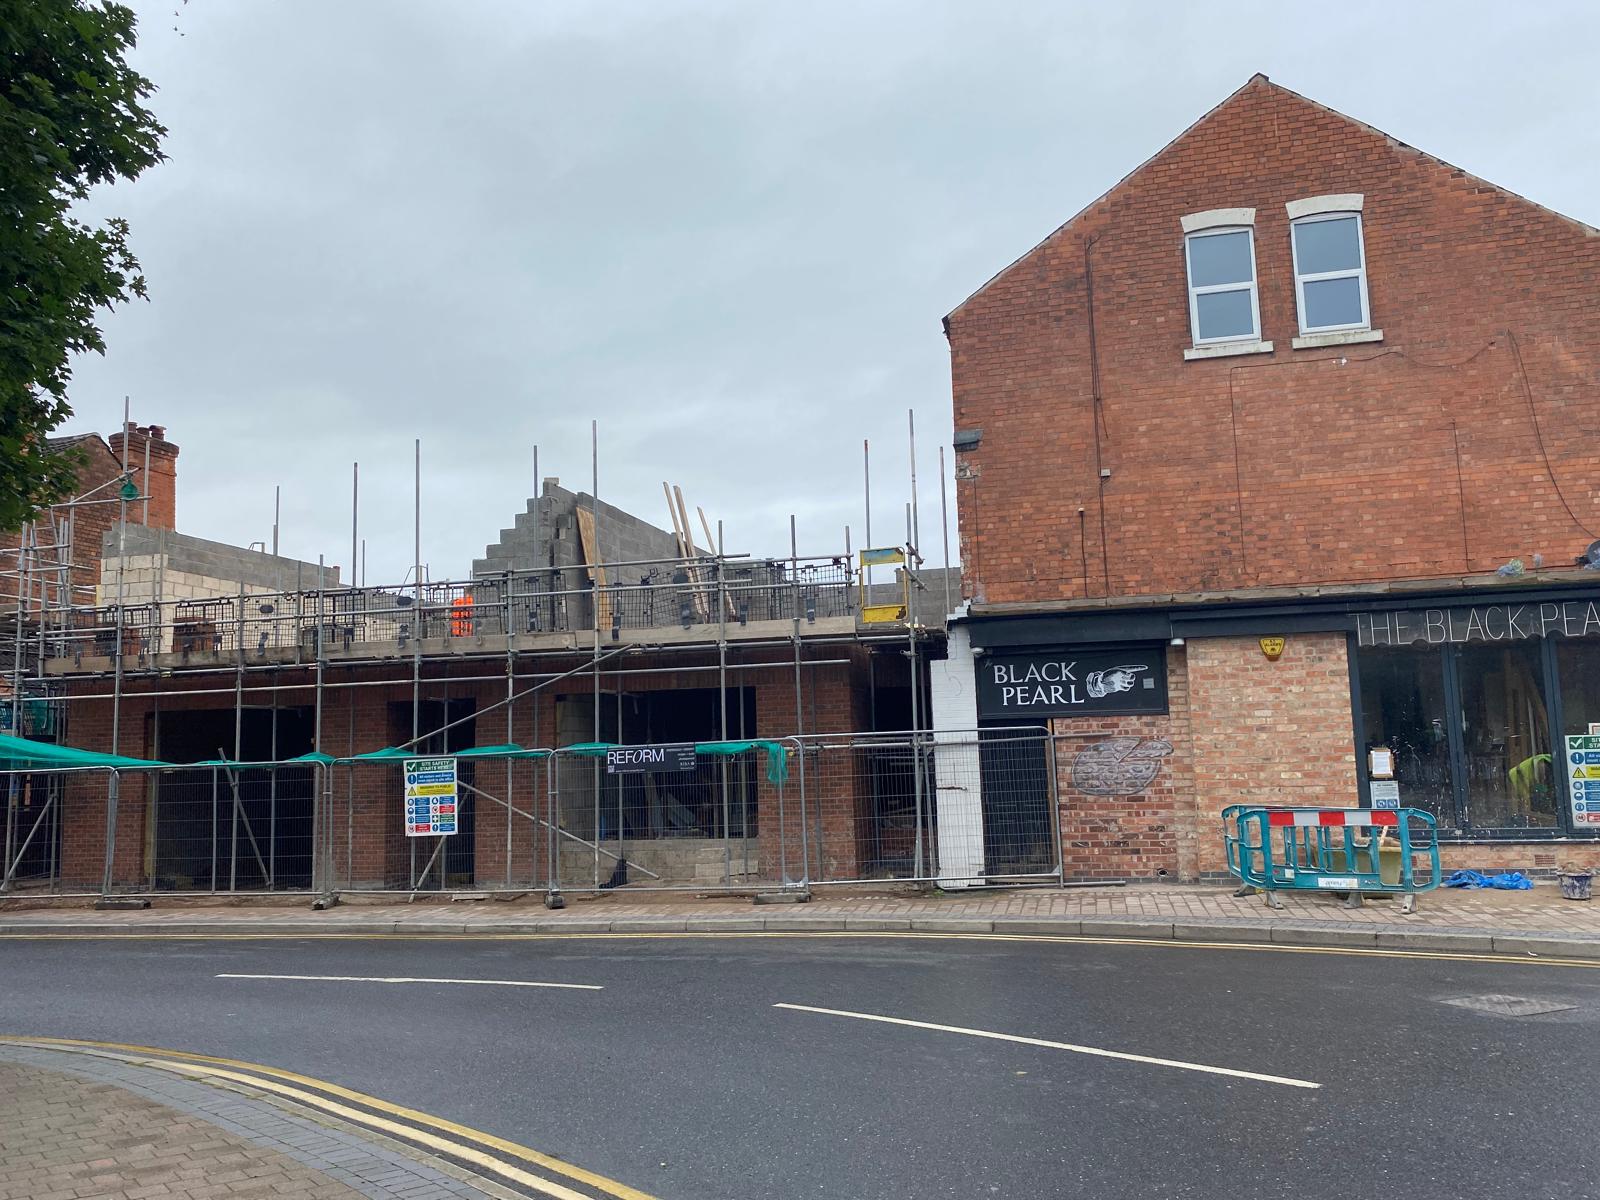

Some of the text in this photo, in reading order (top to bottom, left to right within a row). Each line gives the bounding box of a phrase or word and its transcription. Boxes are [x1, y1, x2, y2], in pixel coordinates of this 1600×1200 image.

[1348, 601, 1600, 646] THE BLACK PEA
[993, 661, 1077, 684] BLACK
[1002, 685, 1084, 706] PEARL
[607, 749, 665, 764] REFORM
